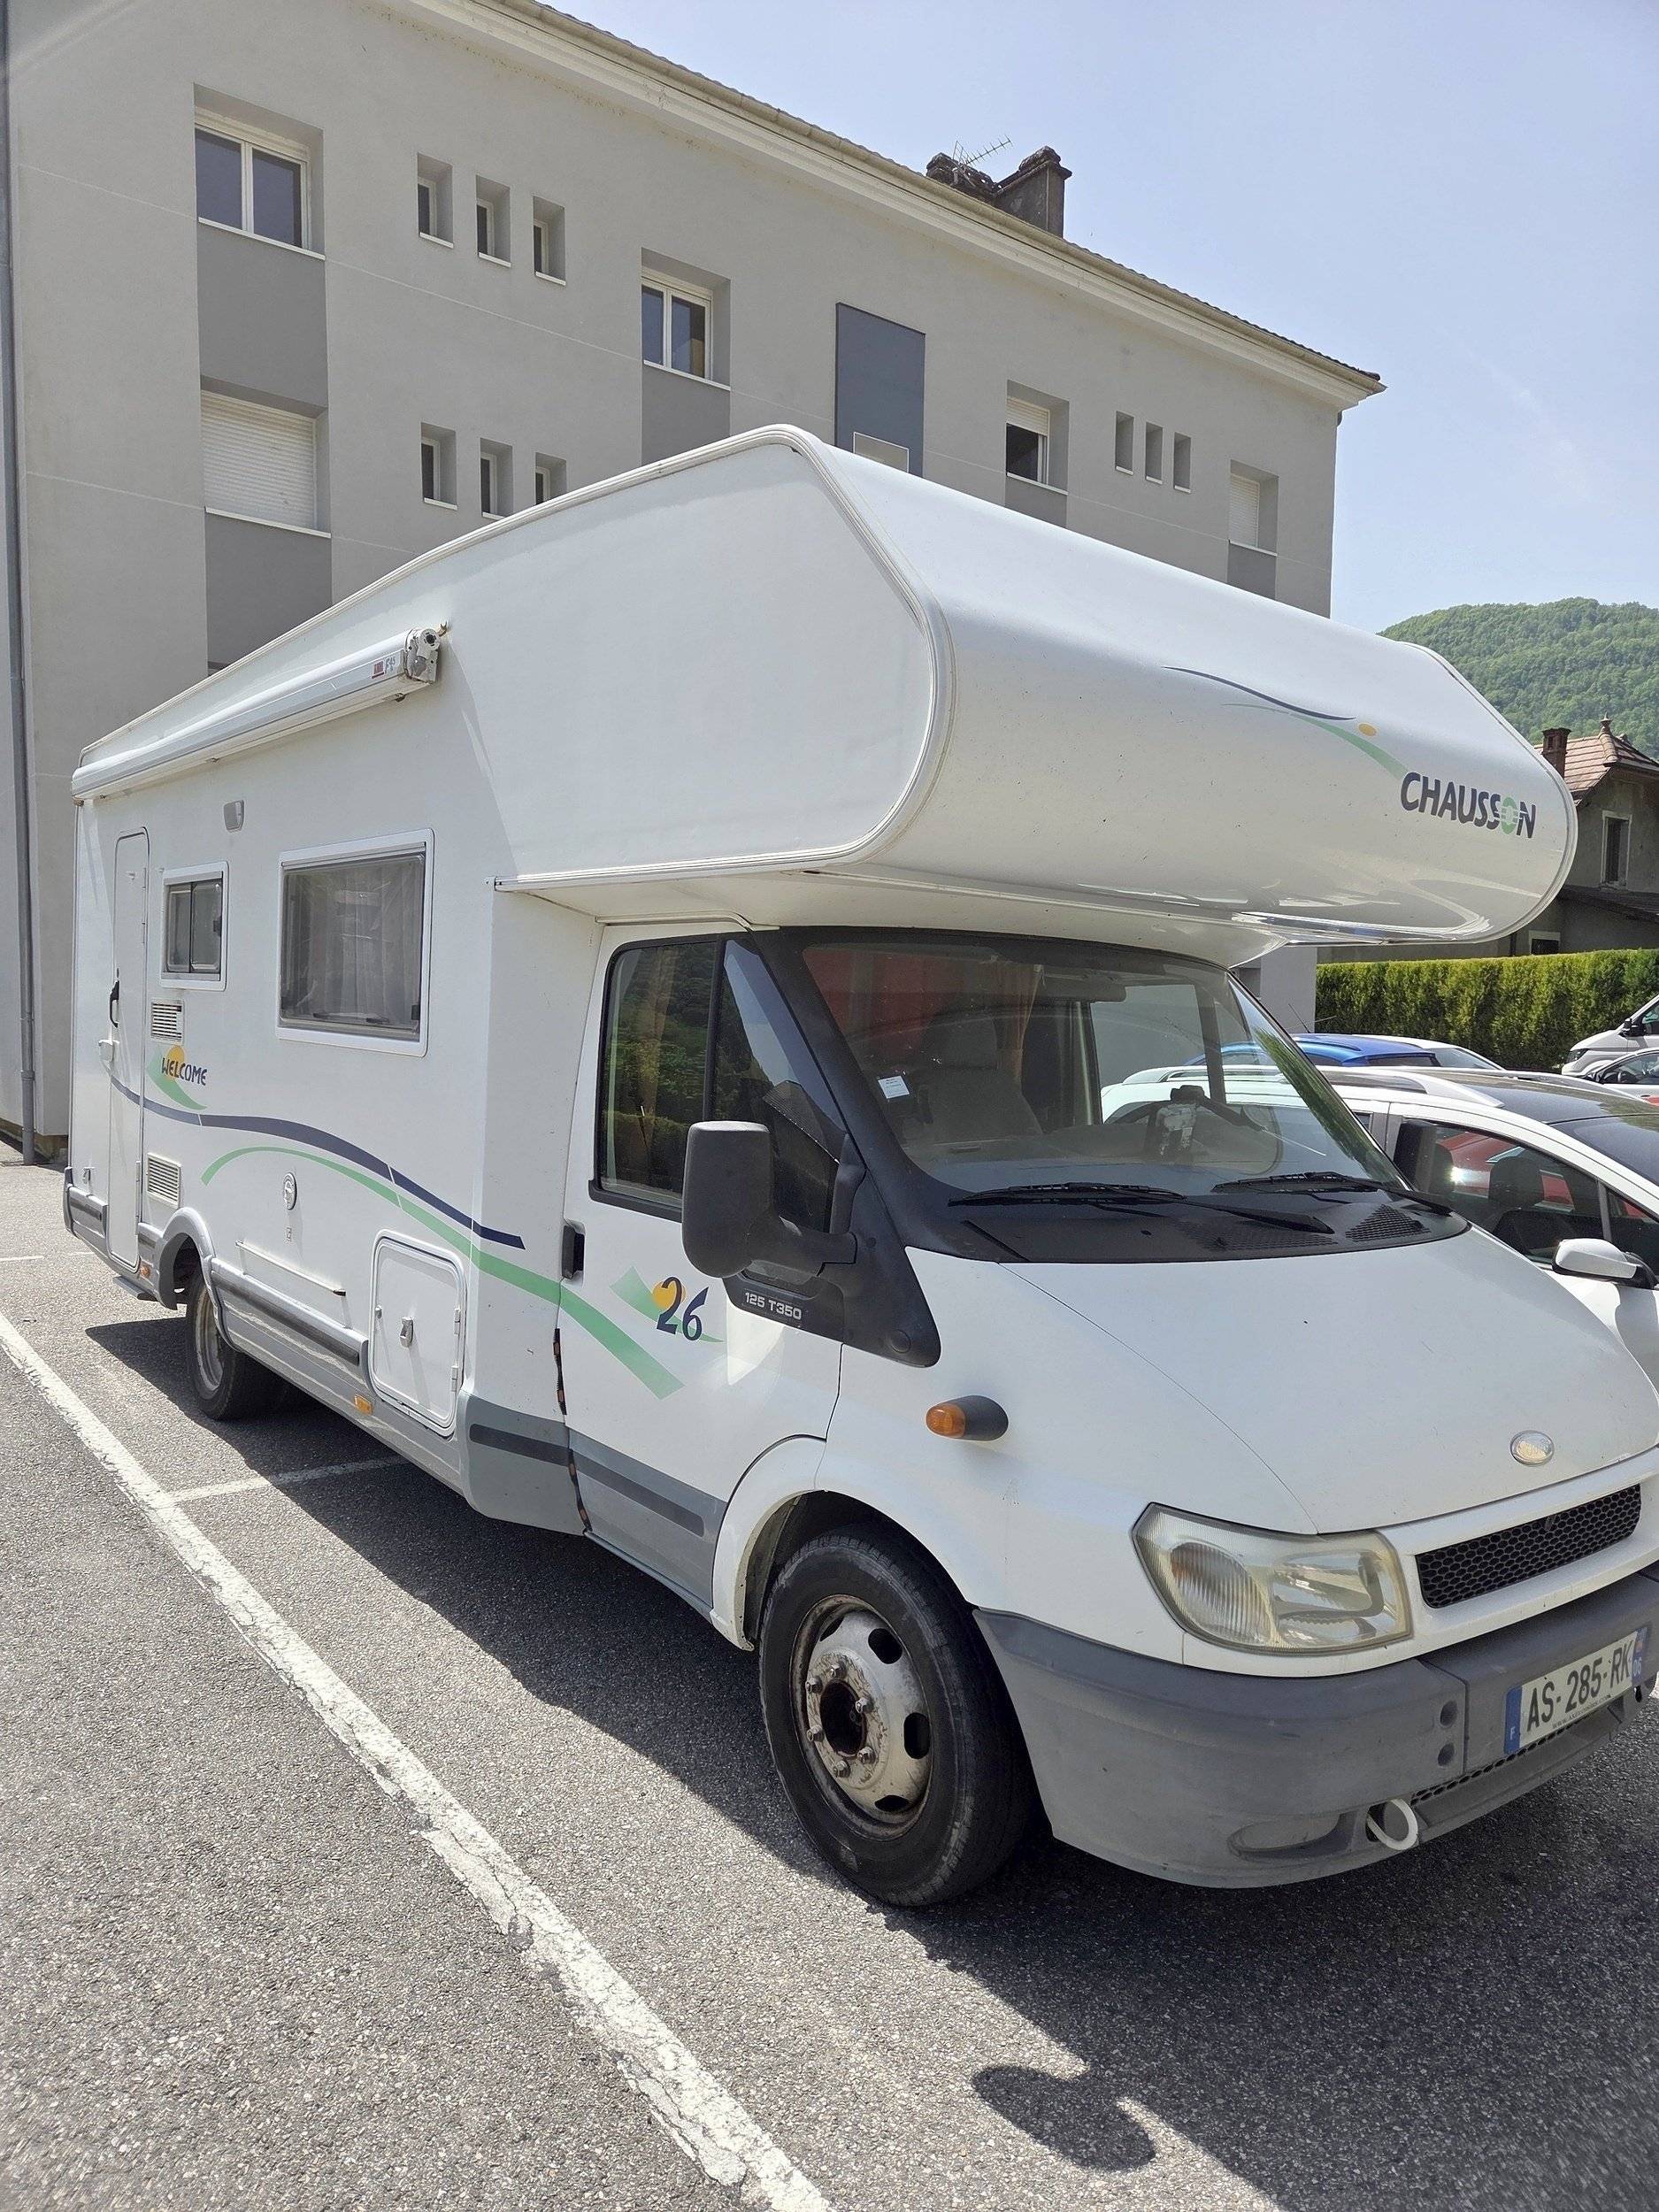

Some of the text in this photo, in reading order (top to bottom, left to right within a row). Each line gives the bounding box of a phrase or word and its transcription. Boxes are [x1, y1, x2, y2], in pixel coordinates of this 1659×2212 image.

[1401, 772, 1536, 839] CHAUSSON
[161, 1057, 207, 1086] WELCOME
[657, 1276, 709, 1341] 26
[744, 1292, 802, 1321] 125 T350
